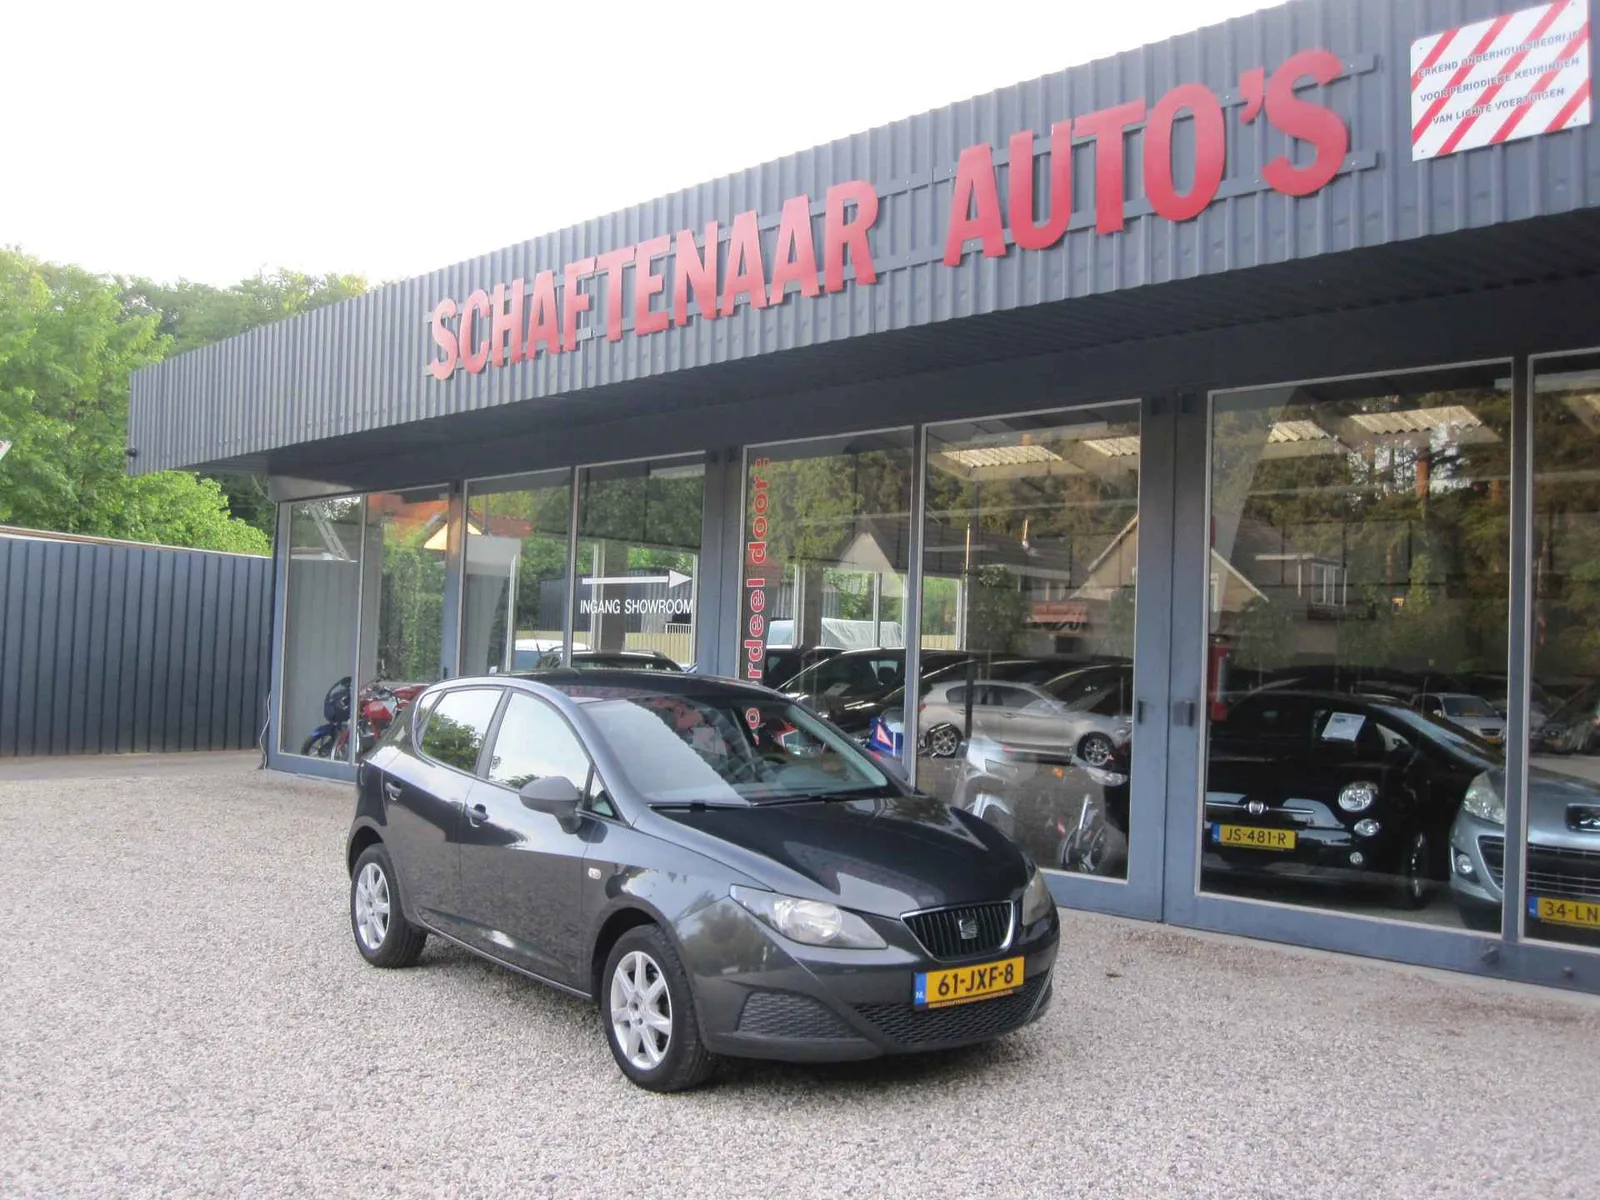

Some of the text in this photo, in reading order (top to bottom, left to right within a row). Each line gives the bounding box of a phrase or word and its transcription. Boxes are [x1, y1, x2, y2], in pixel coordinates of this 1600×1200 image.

[1418, 60, 1459, 79] ERKEND
[1420, 56, 1581, 103] VOOR PERIODIEKE KEURINGEN
[1432, 86, 1565, 125] VAN LICHTE VOERTUIGEN
[428, 47, 1349, 381] SCHAFTENAAR AUTO'S
[580, 599, 693, 615] INGANG SHOWROOM
[744, 577, 766, 747] ordeel
[1226, 828, 1288, 846] JS-481-R
[938, 963, 1014, 996] 61-JXF-8
